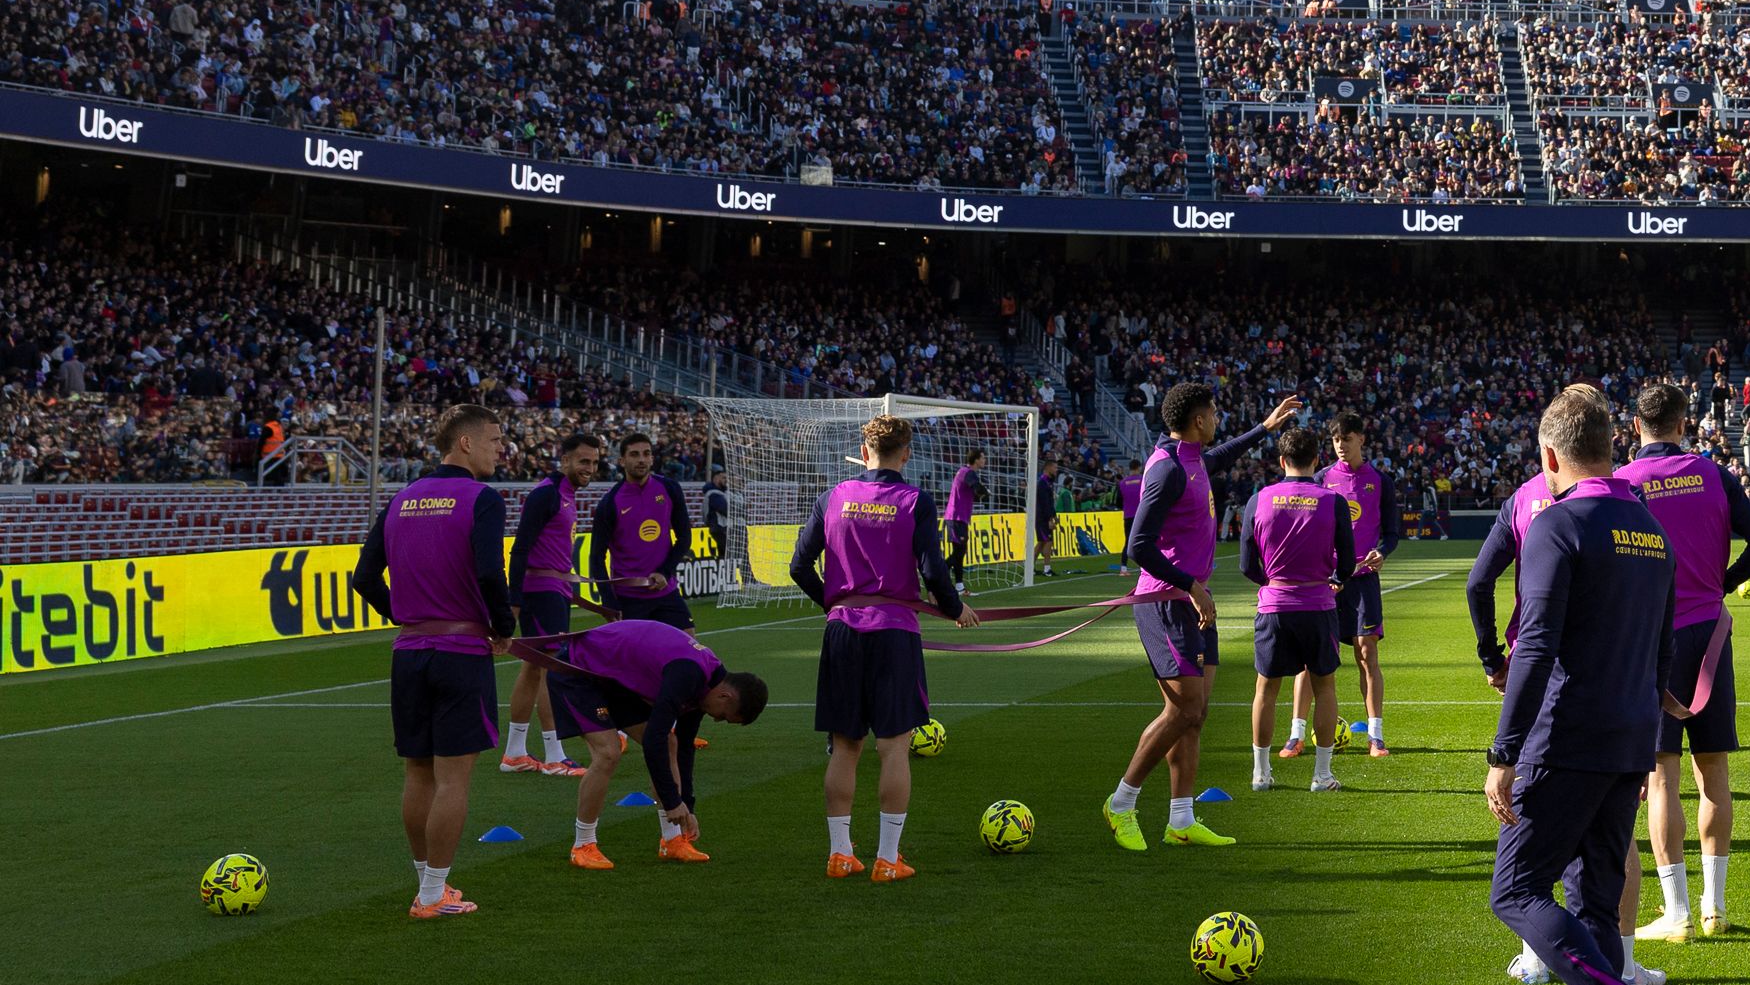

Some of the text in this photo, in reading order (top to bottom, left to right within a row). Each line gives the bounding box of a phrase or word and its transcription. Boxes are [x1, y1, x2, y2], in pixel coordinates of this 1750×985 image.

[79, 107, 143, 143] Uber
[304, 137, 363, 171] Uber
[511, 163, 565, 194] Uber
[716, 184, 776, 211] Uber
[941, 197, 1004, 223] Uber
[1173, 205, 1235, 232] Uber
[1402, 209, 1464, 232] Uber
[1627, 211, 1688, 235] Uber
[1642, 475, 1703, 494] R.D. CONGO
[419, 497, 456, 509] CONGO
[861, 503, 897, 515] CONGO
[1611, 529, 1664, 550] R.D. CONGO
[1631, 547, 1639, 556] DE
[1639, 549, 1667, 560] L'AFRIQUE
